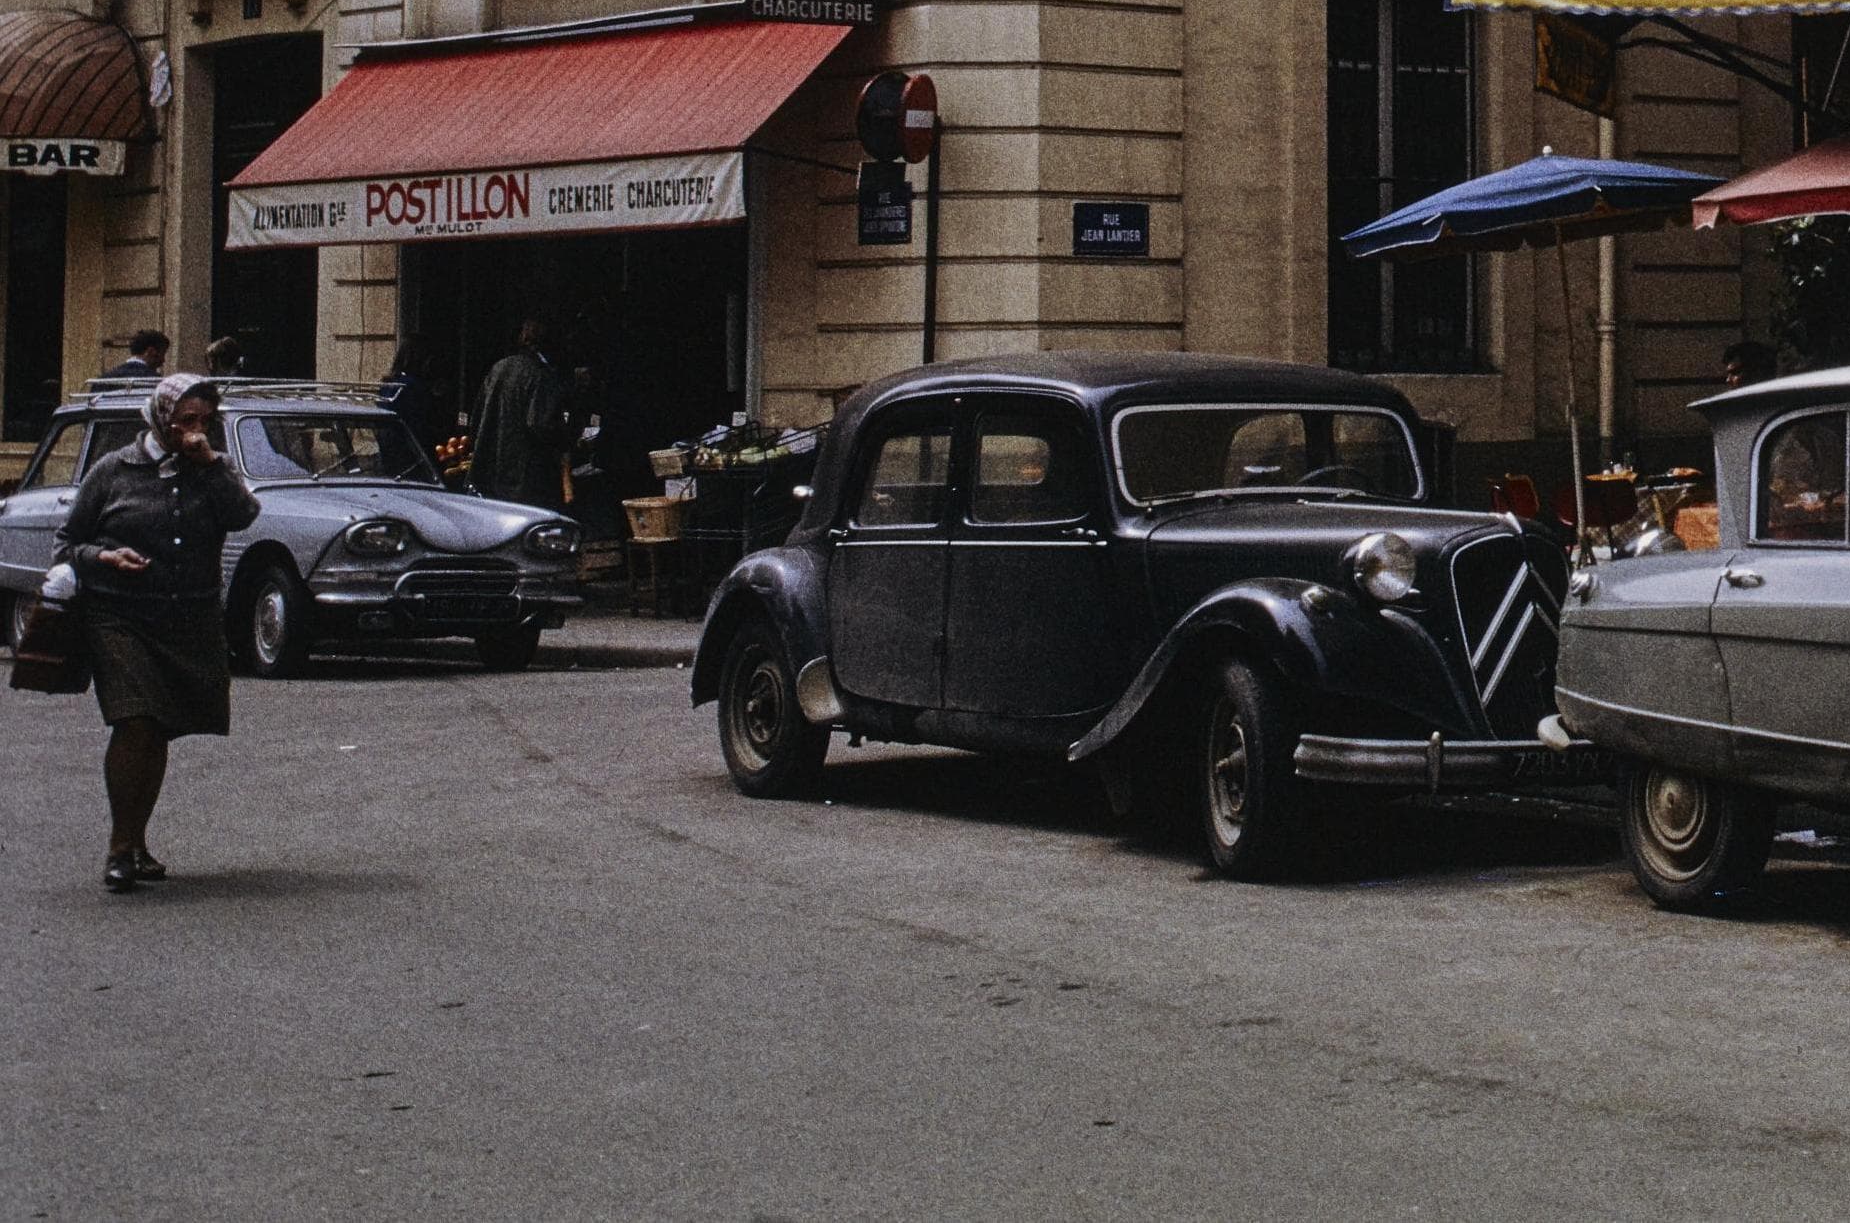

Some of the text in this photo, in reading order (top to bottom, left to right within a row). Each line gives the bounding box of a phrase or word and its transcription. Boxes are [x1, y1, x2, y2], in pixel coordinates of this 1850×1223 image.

[8, 143, 101, 168] BAR
[366, 172, 531, 227] POSTILLON
[627, 175, 716, 210] CHARCUTERIE
[252, 202, 325, 231] ALIMENTATION
[437, 221, 483, 234] MULOT
[1102, 213, 1121, 226] RUE
[1080, 229, 1141, 242] JEAN LANTIER
